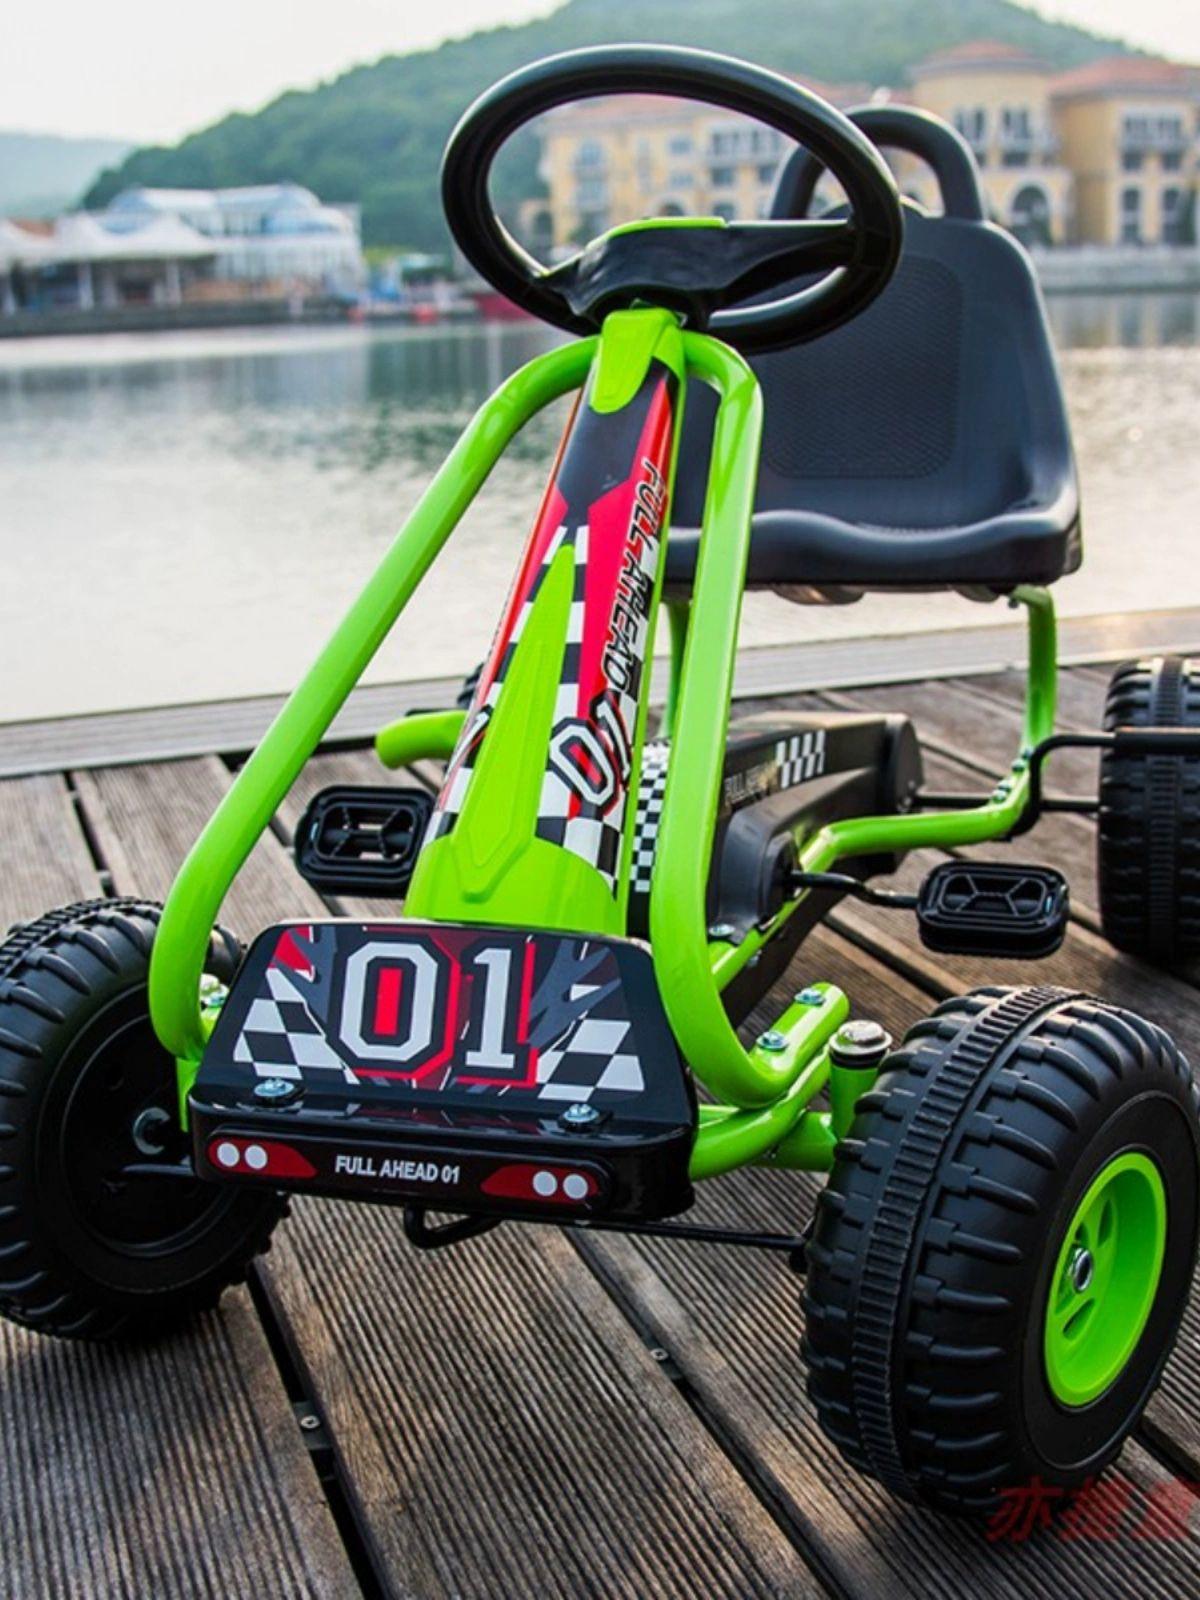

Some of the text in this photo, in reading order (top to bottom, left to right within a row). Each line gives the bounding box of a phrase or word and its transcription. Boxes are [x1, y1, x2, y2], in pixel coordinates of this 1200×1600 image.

[602, 457, 665, 692] FULL AHEAD
[549, 699, 630, 806] 01
[339, 941, 514, 1068] 01
[335, 1155, 460, 1184] FULL AHEAD 01
